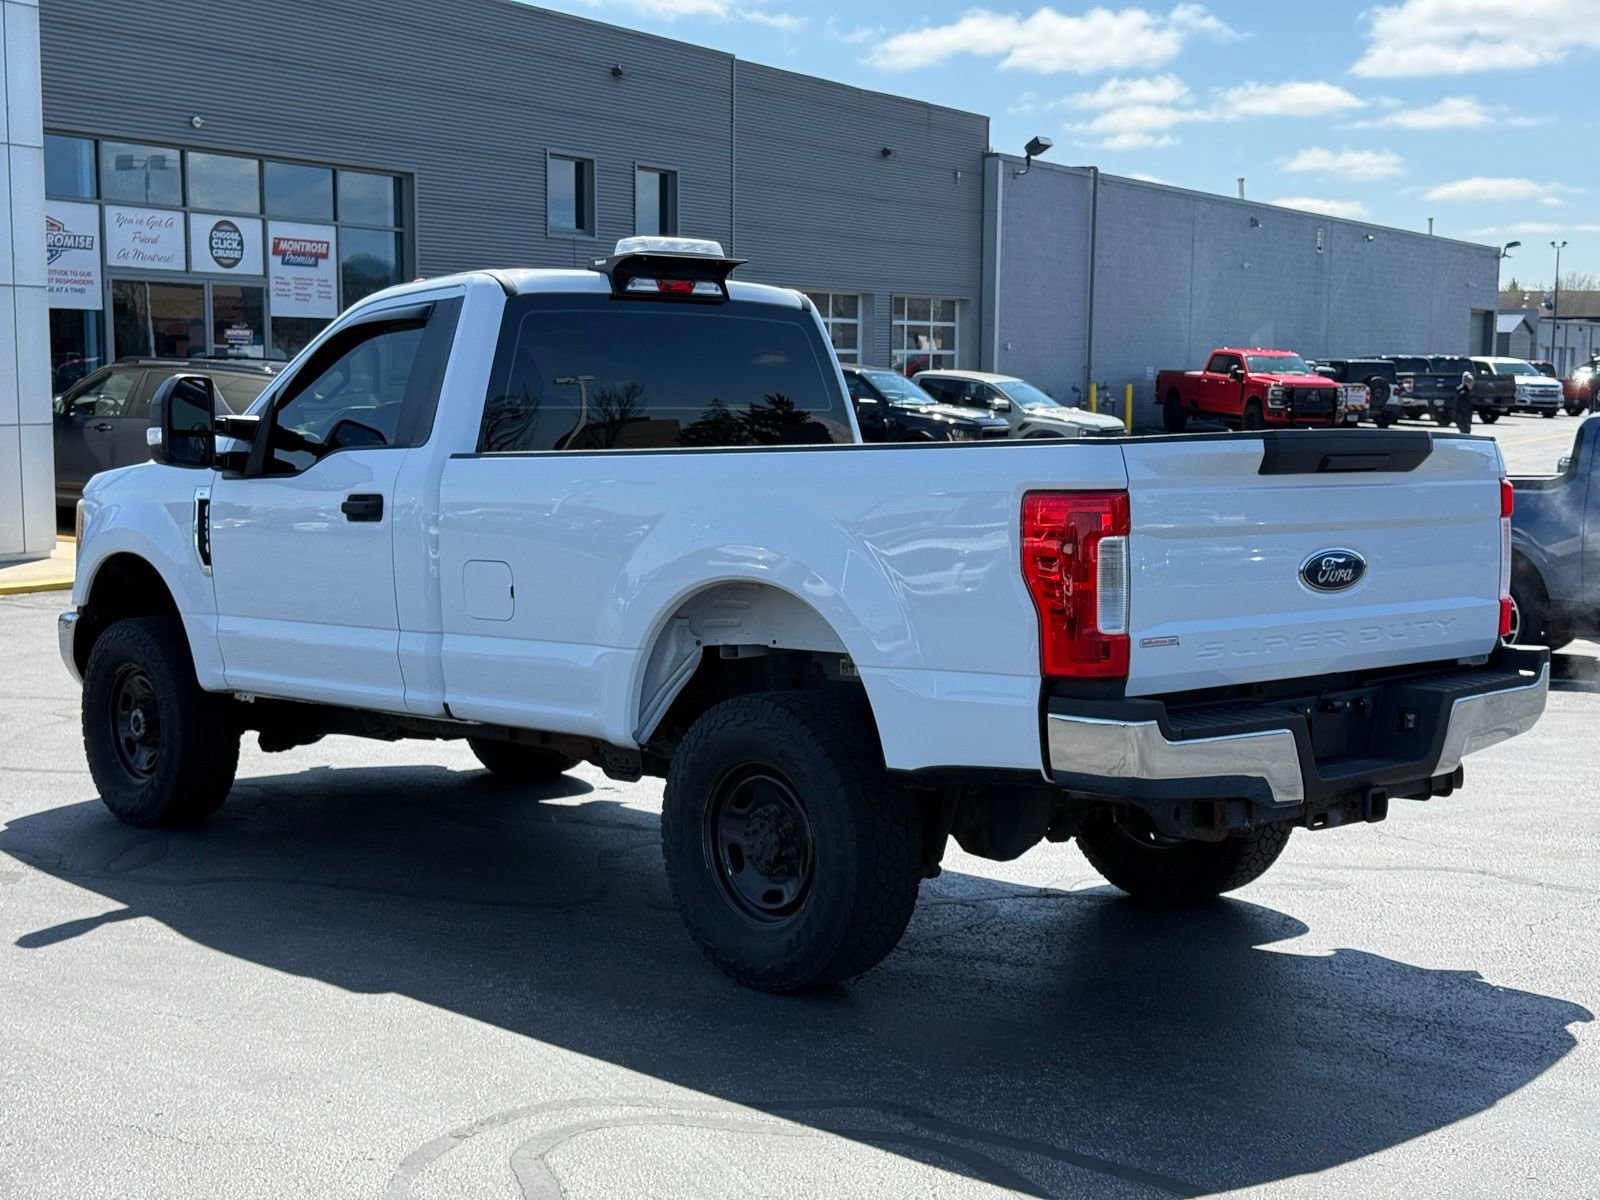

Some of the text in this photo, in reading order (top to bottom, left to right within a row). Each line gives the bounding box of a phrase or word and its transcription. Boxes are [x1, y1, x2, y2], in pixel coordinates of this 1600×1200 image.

[165, 217, 174, 229] A
[47, 234, 93, 248] ROMISE
[131, 231, 160, 244] Friend
[212, 249, 242, 258] CRUISE!
[279, 240, 328, 254] MONTROSE
[283, 252, 316, 265] Promise
[1317, 556, 1355, 584] Ford
[1196, 617, 1457, 660] SUPER DUTY
